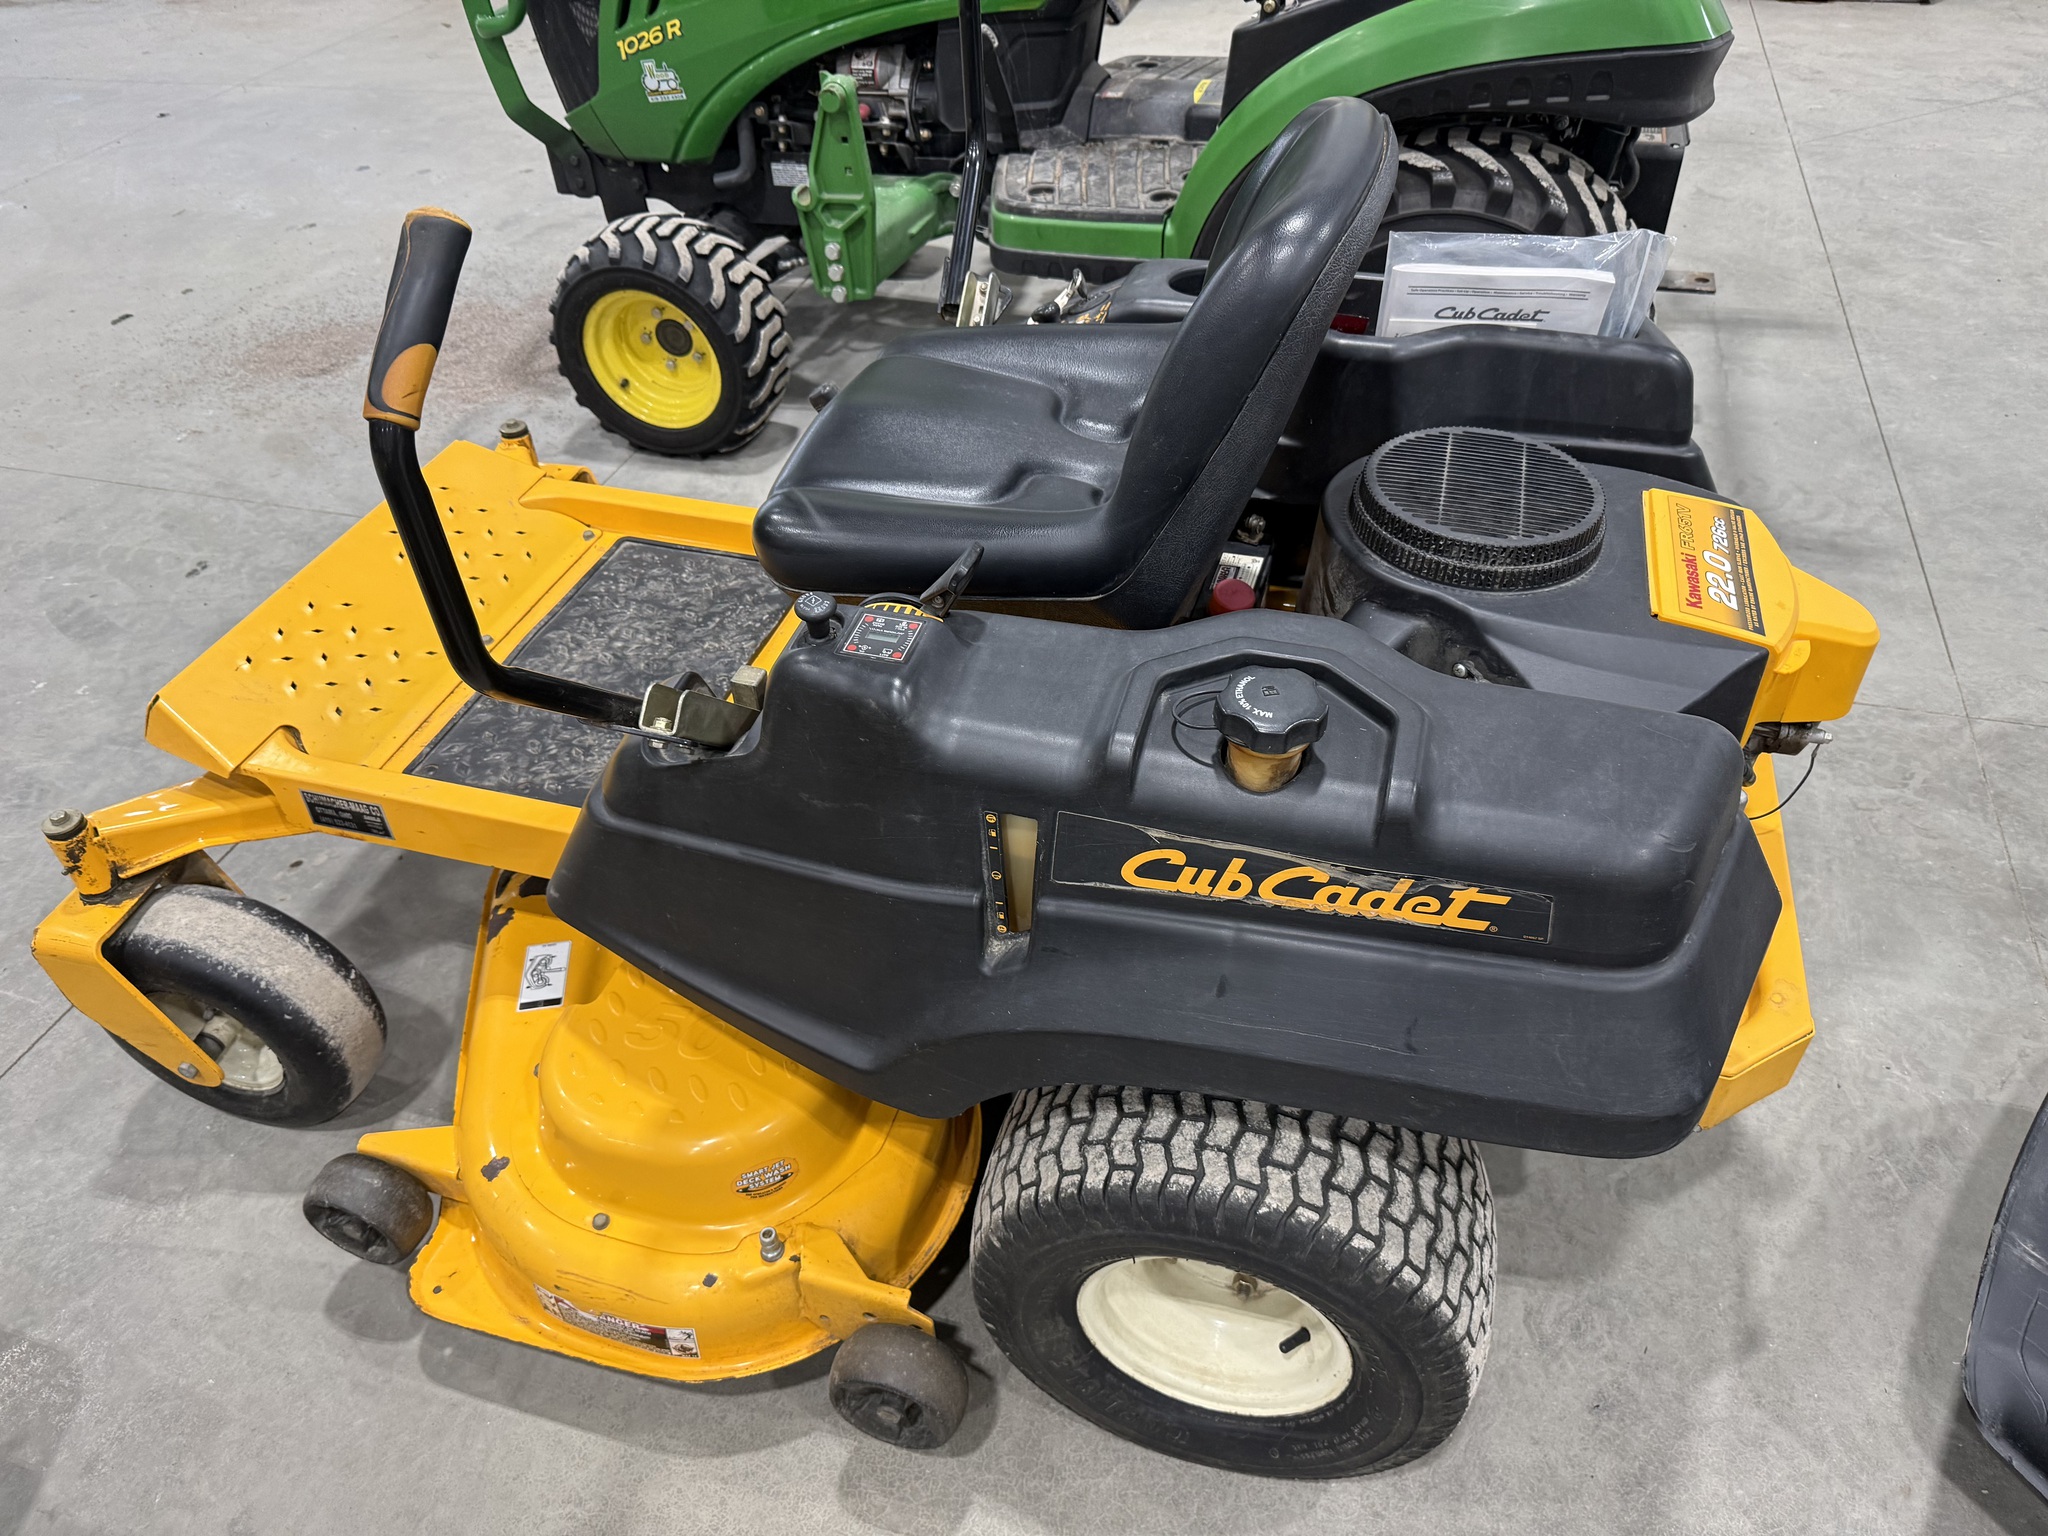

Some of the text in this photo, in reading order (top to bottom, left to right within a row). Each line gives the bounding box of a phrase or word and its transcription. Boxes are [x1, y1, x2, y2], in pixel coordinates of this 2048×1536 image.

[616, 18, 683, 61] 1026 R
[1434, 306, 1550, 322] Cub Cadet
[1676, 503, 1703, 609] Kawasaki FR651V
[1702, 516, 1739, 611] 22.0 726cc
[1235, 675, 1256, 699] ETHANOL
[1238, 698, 1252, 710] 10%
[1120, 848, 1512, 931] Cub Cadet
[736, 1163, 791, 1187] DECK WASH
[741, 1159, 785, 1179] SMART JET
[600, 1315, 641, 1330] ANGER
